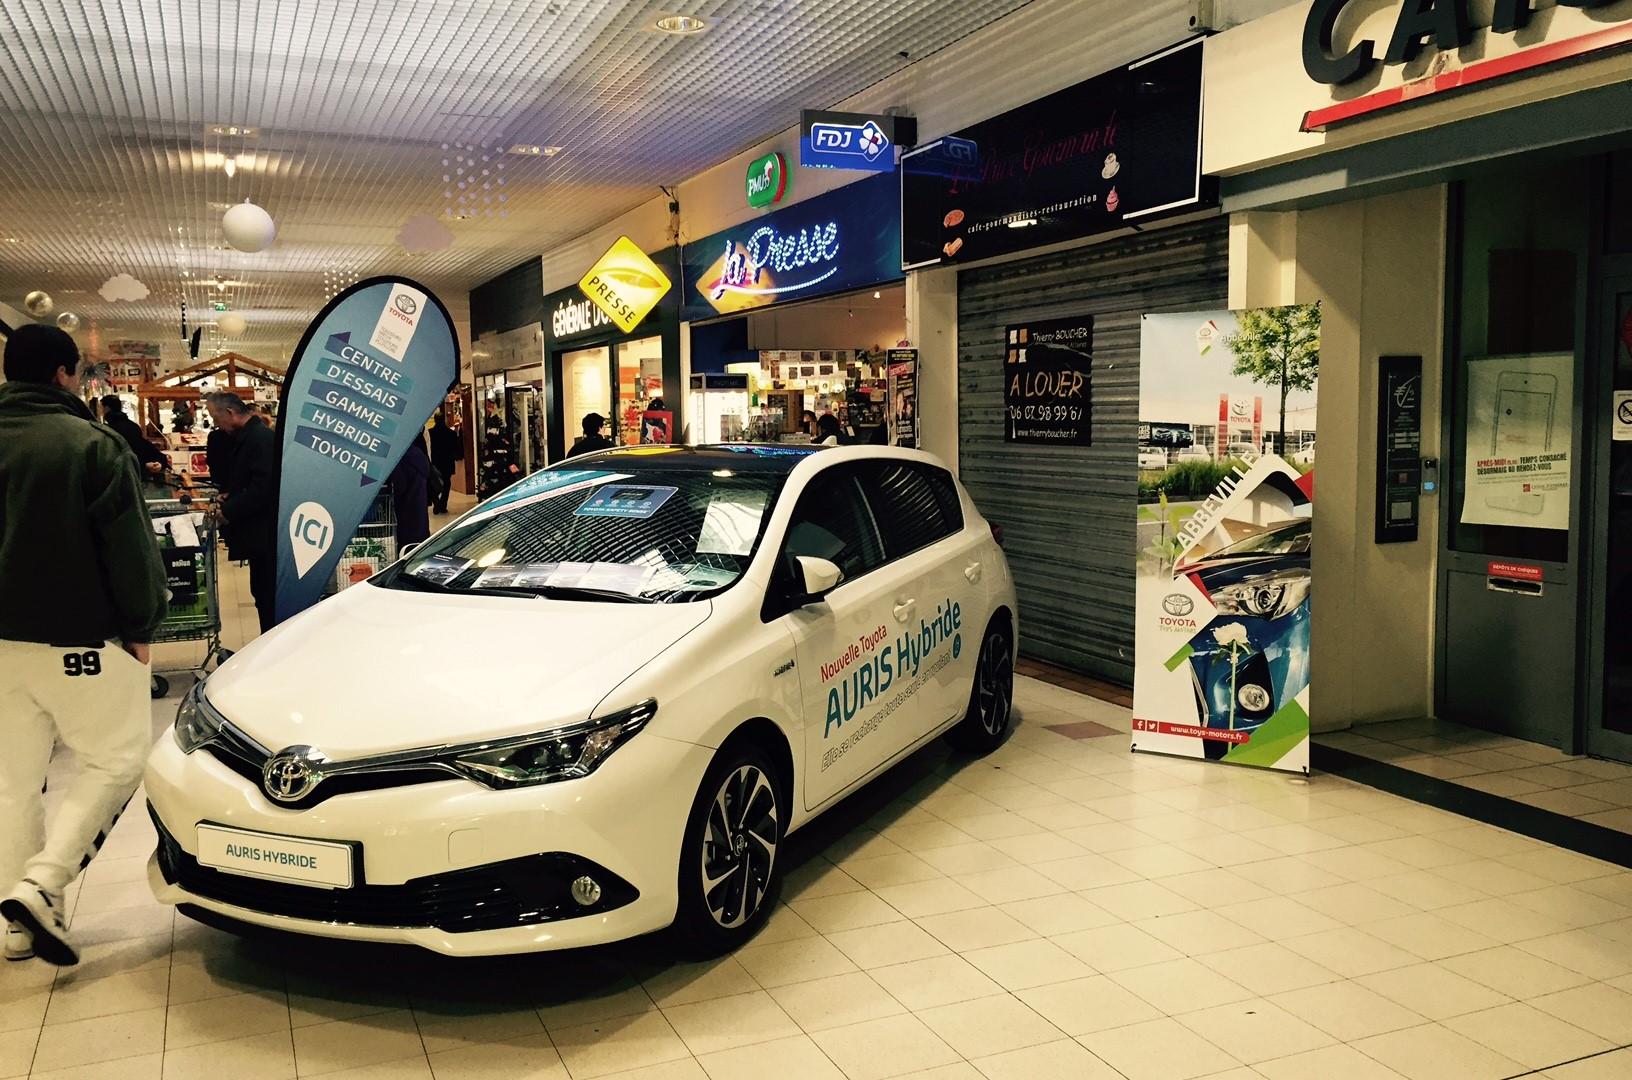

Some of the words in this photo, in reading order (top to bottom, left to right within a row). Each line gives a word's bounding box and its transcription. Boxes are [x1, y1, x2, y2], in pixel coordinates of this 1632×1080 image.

[816, 129, 851, 148] FDJ
[747, 222, 839, 284] Presse
[389, 307, 413, 326] TOYOTA
[588, 276, 636, 323] PRESSE
[553, 299, 592, 338] GÉNÉRALE
[1055, 328, 1087, 340] BOUCHER
[340, 346, 402, 386] CENTRE
[1010, 373, 1020, 397] A
[1025, 371, 1083, 398] LOUER
[326, 365, 398, 408] D'ESSAIS
[326, 391, 384, 428] GAMME
[1038, 404, 1052, 421] 98
[1053, 405, 1067, 421] 99
[312, 410, 381, 452] HYBRIDE
[311, 435, 368, 474] TOYOTA
[1520, 456, 1537, 464] TEMPS
[1176, 450, 1258, 550] ABBEVILLE
[294, 513, 329, 550] ICI
[1160, 617, 1196, 627] TOYOTA
[64, 651, 101, 676] 99
[821, 643, 860, 683] Nouvelle
[859, 625, 888, 654] Toyota
[823, 646, 893, 739] AURIS
[897, 598, 961, 678] Hybride
[1170, 726, 1243, 740] www.toys-motors.fr
[226, 844, 261, 860] AURIS
[263, 850, 317, 869] HYBRIDE
